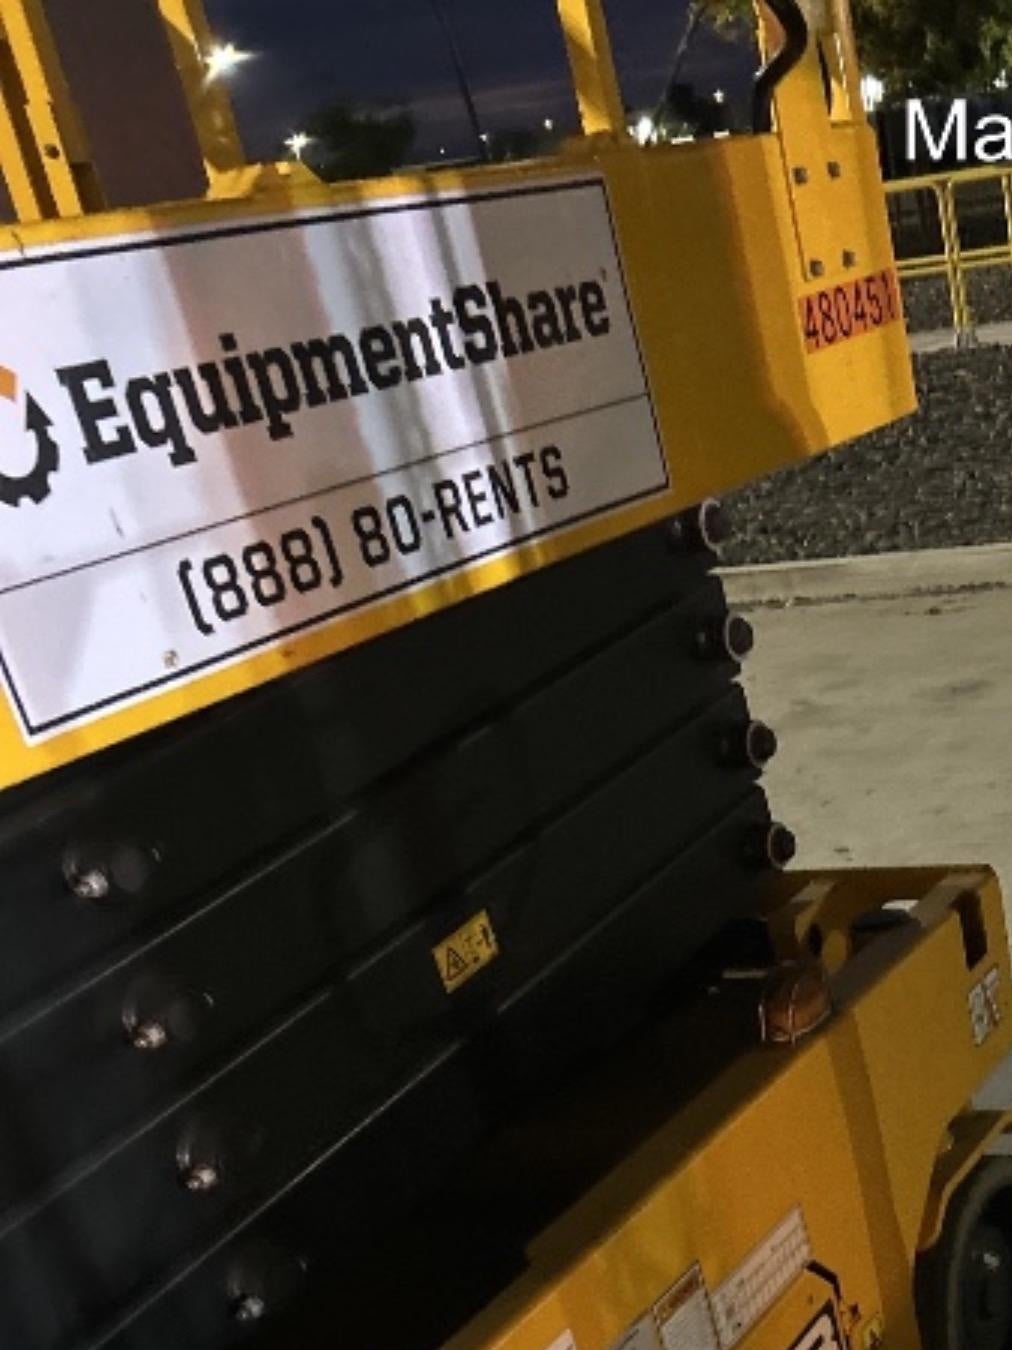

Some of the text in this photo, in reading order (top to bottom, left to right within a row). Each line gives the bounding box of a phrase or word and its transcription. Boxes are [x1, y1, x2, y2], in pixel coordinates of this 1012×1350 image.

[55, 278, 612, 468] EquipmentShare
[176, 444, 571, 636] (888) 80-RENTS
